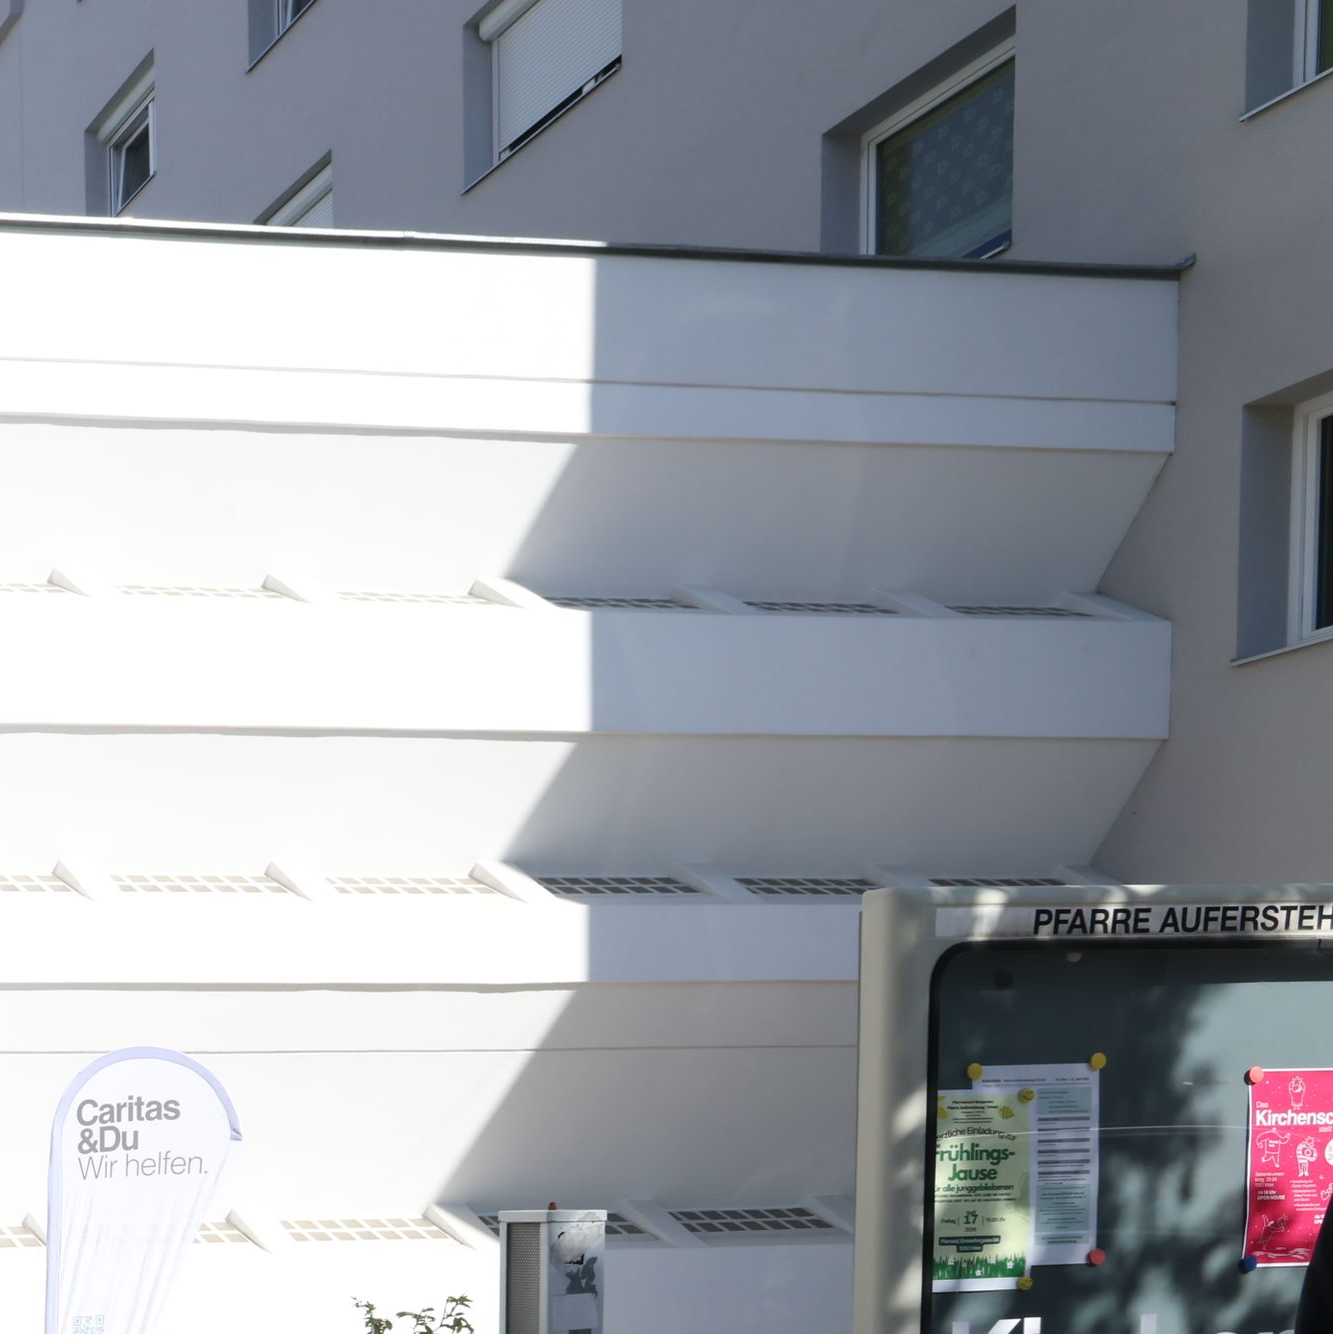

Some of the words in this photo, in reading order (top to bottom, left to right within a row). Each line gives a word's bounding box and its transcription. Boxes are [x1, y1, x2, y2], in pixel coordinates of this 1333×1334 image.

[1034, 908, 1152, 935] PFARRE
[76, 1095, 181, 1127] Caritas
[77, 1125, 139, 1155] &Du
[78, 1154, 118, 1181] Wir
[125, 1150, 208, 1177] helfen.
[948, 1163, 998, 1181] Jause
[963, 1214, 978, 1225] 17
